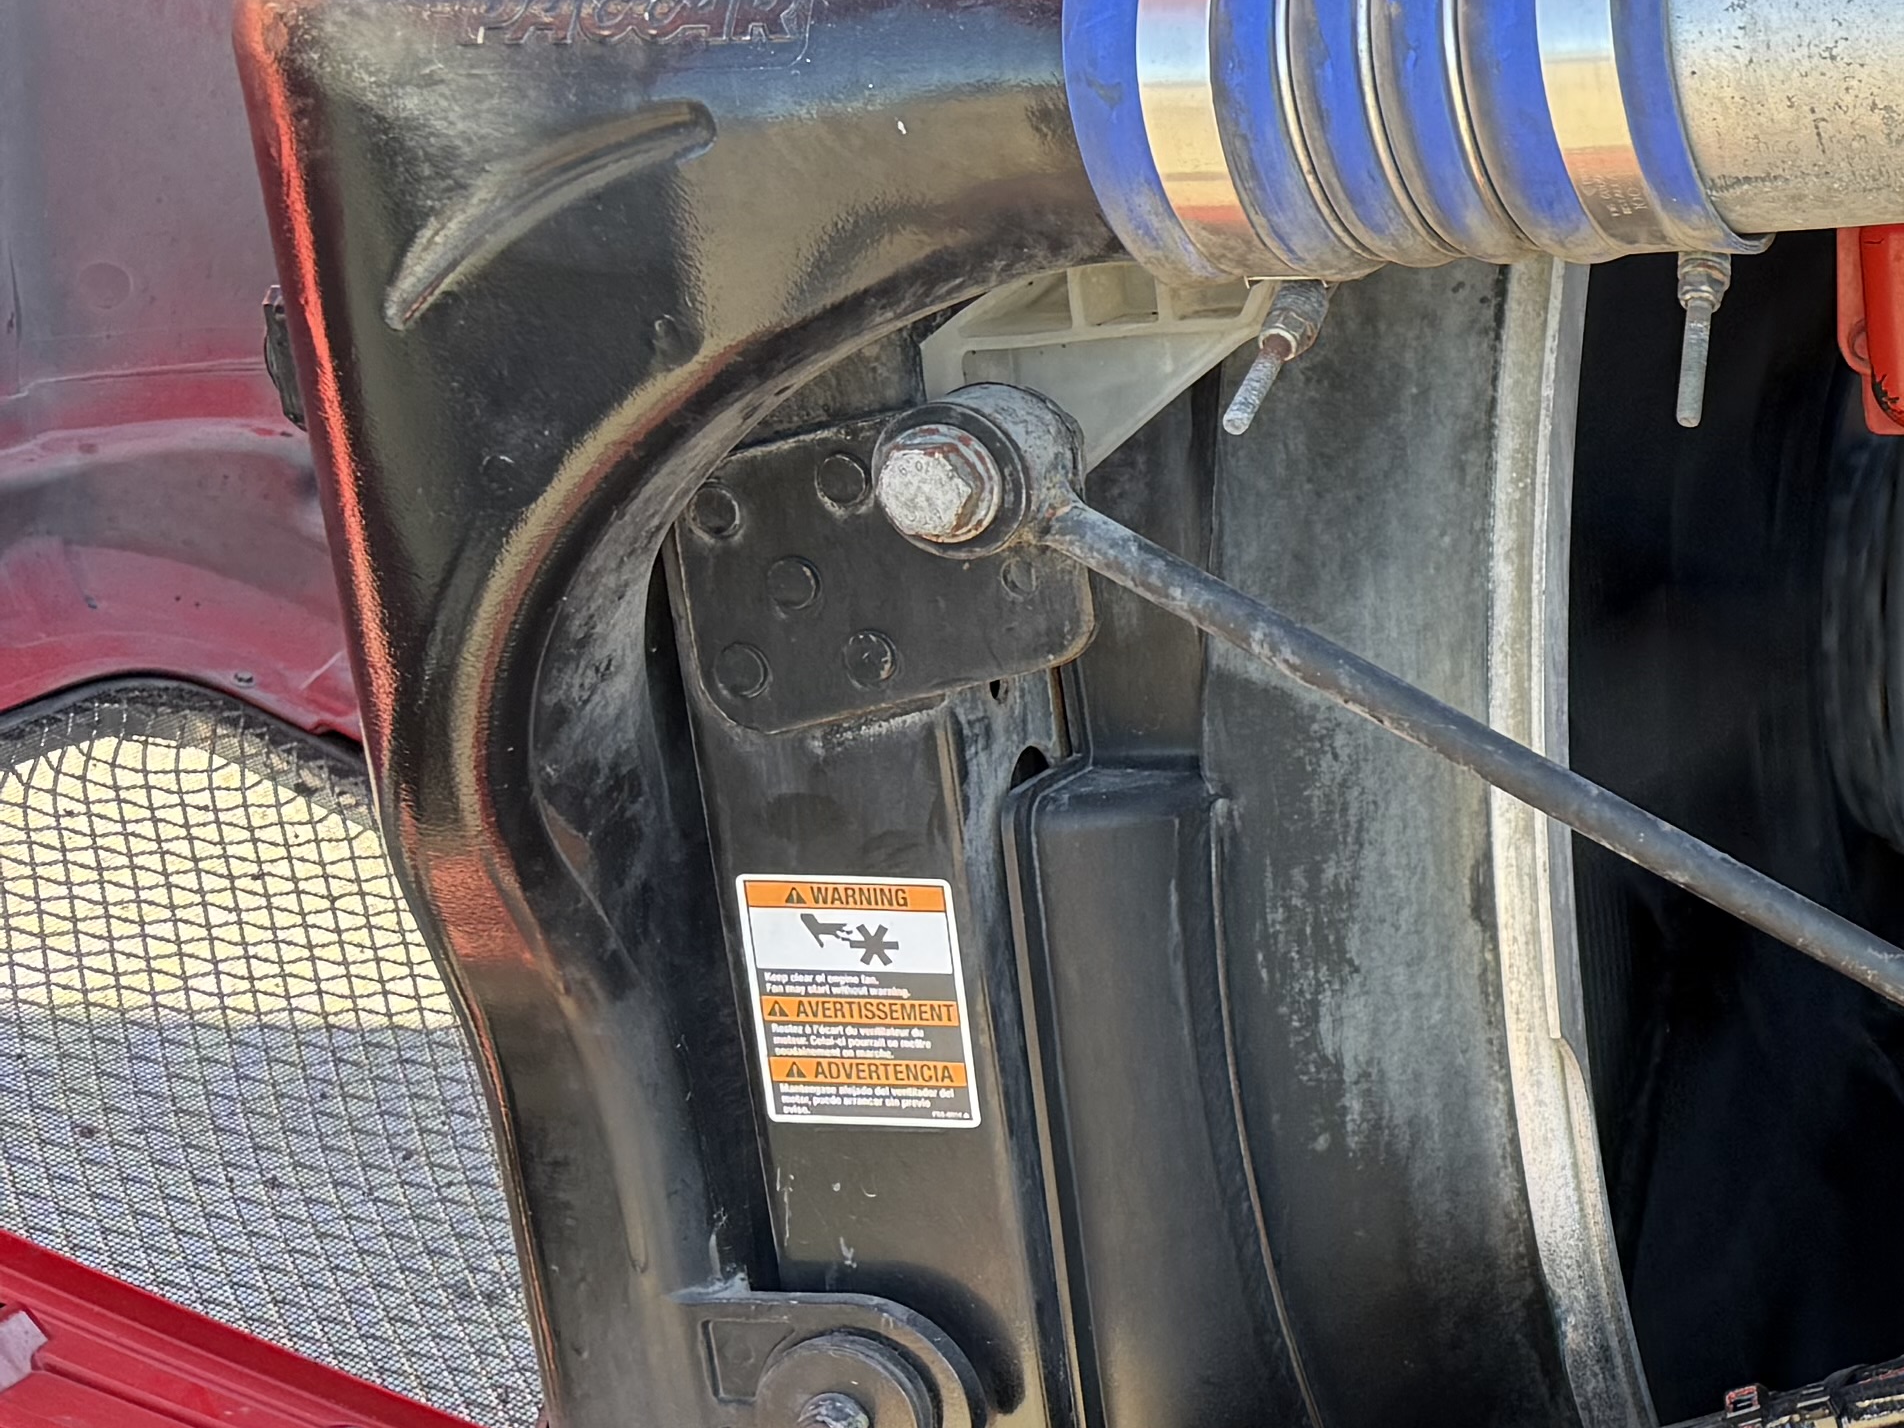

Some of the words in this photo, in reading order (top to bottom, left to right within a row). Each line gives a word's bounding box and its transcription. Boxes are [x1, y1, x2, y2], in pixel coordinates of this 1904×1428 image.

[811, 885, 909, 908] WARNING
[764, 972, 789, 983] Keep
[790, 973, 814, 983] clear
[796, 999, 955, 1022] AVERTISSEMENT
[814, 1060, 955, 1084] ADVERTENCIA
